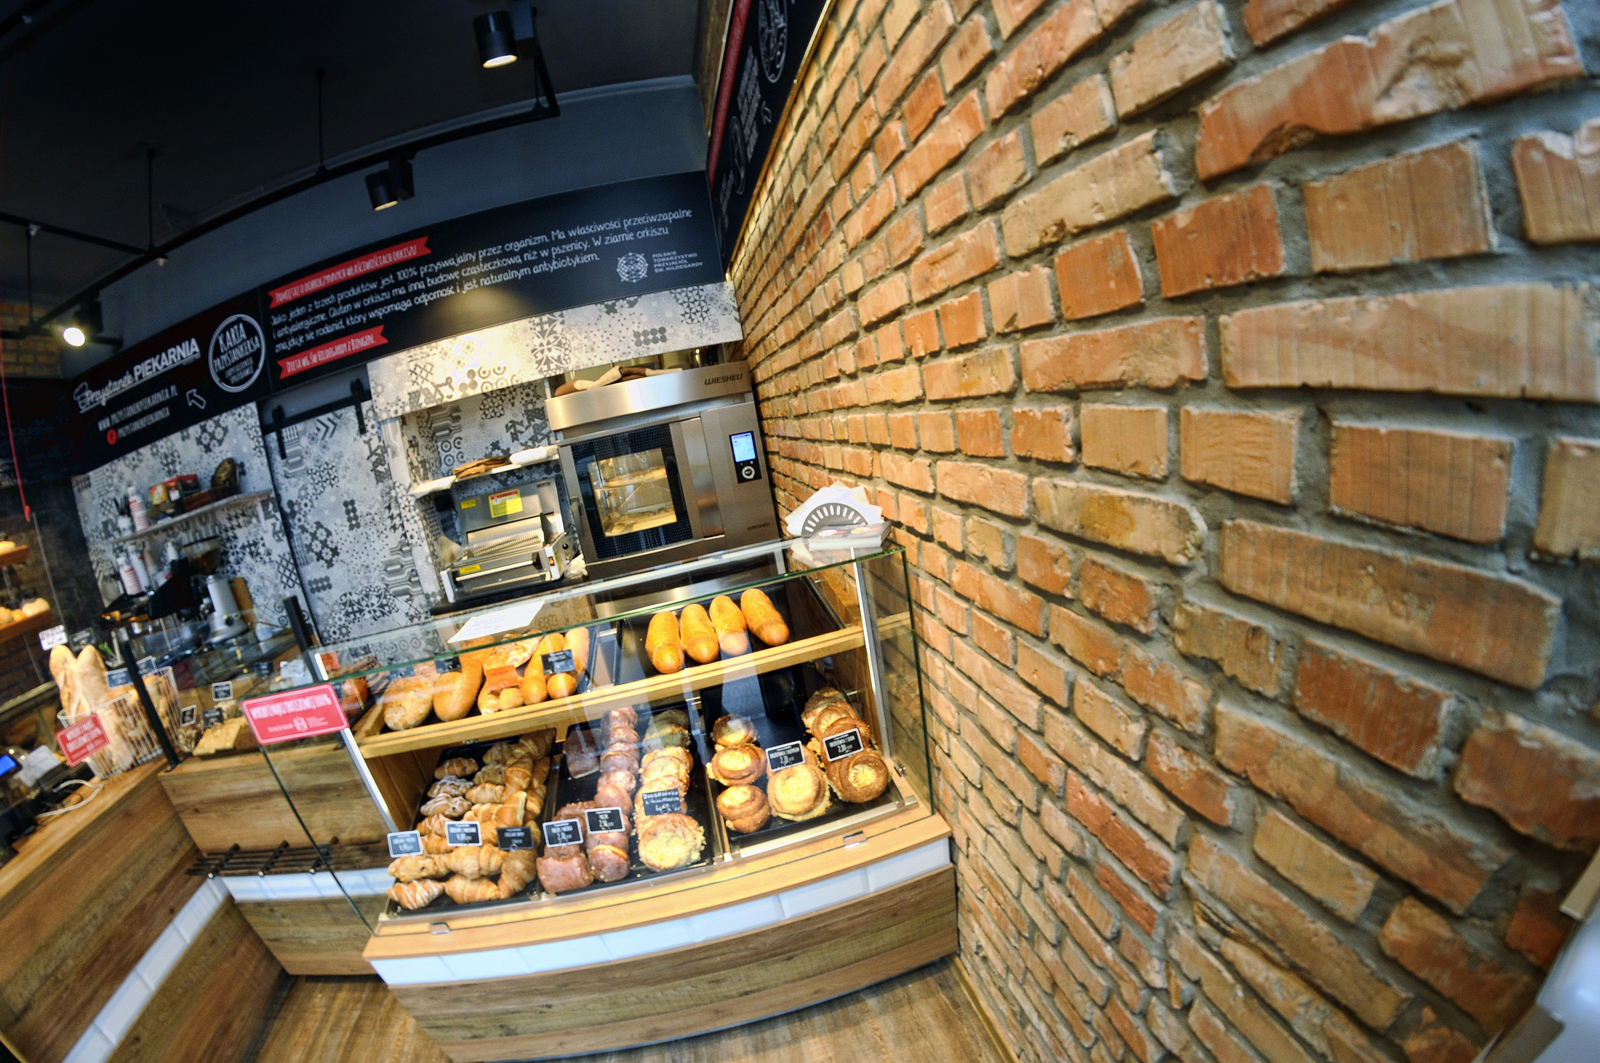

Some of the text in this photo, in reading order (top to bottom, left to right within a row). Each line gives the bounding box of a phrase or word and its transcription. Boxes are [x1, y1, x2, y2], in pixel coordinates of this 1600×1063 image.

[271, 208, 693, 326] Jako jeden z trzech produktów jest 100% przyswajalny przez organizm. Ma właściwości przeciwzapalne
[652, 250, 677, 259] POLSKIE
[653, 252, 698, 263] TOWARZYSTWO
[665, 262, 703, 271] HILDEGARDY
[328, 303, 353, 319] Gluten
[353, 300, 361, 309] w
[362, 290, 391, 307] orkiszu
[392, 285, 406, 297] ma
[408, 280, 426, 292] inną
[426, 270, 460, 287] budowę
[461, 254, 522, 277] cząsteczkową
[523, 249, 538, 262] niż
[539, 248, 549, 258] w
[550, 239, 591, 259] pszenicy.
[591, 234, 602, 247] W
[604, 230, 635, 245] ziarnie
[636, 226, 669, 239] orkiszu
[274, 334, 305, 353] znajduje
[304, 329, 315, 341] się
[345, 312, 367, 326] który
[367, 298, 413, 320] wspomaga
[413, 284, 455, 306] odporność
[456, 282, 460, 293] i
[461, 278, 479, 294] jest
[480, 266, 531, 287] naturalnym
[532, 252, 600, 274] antybiotykiem.
[218, 322, 247, 353] KARTA
[133, 337, 200, 381] PIEKARNIA
[704, 373, 743, 386] WIESHEU
